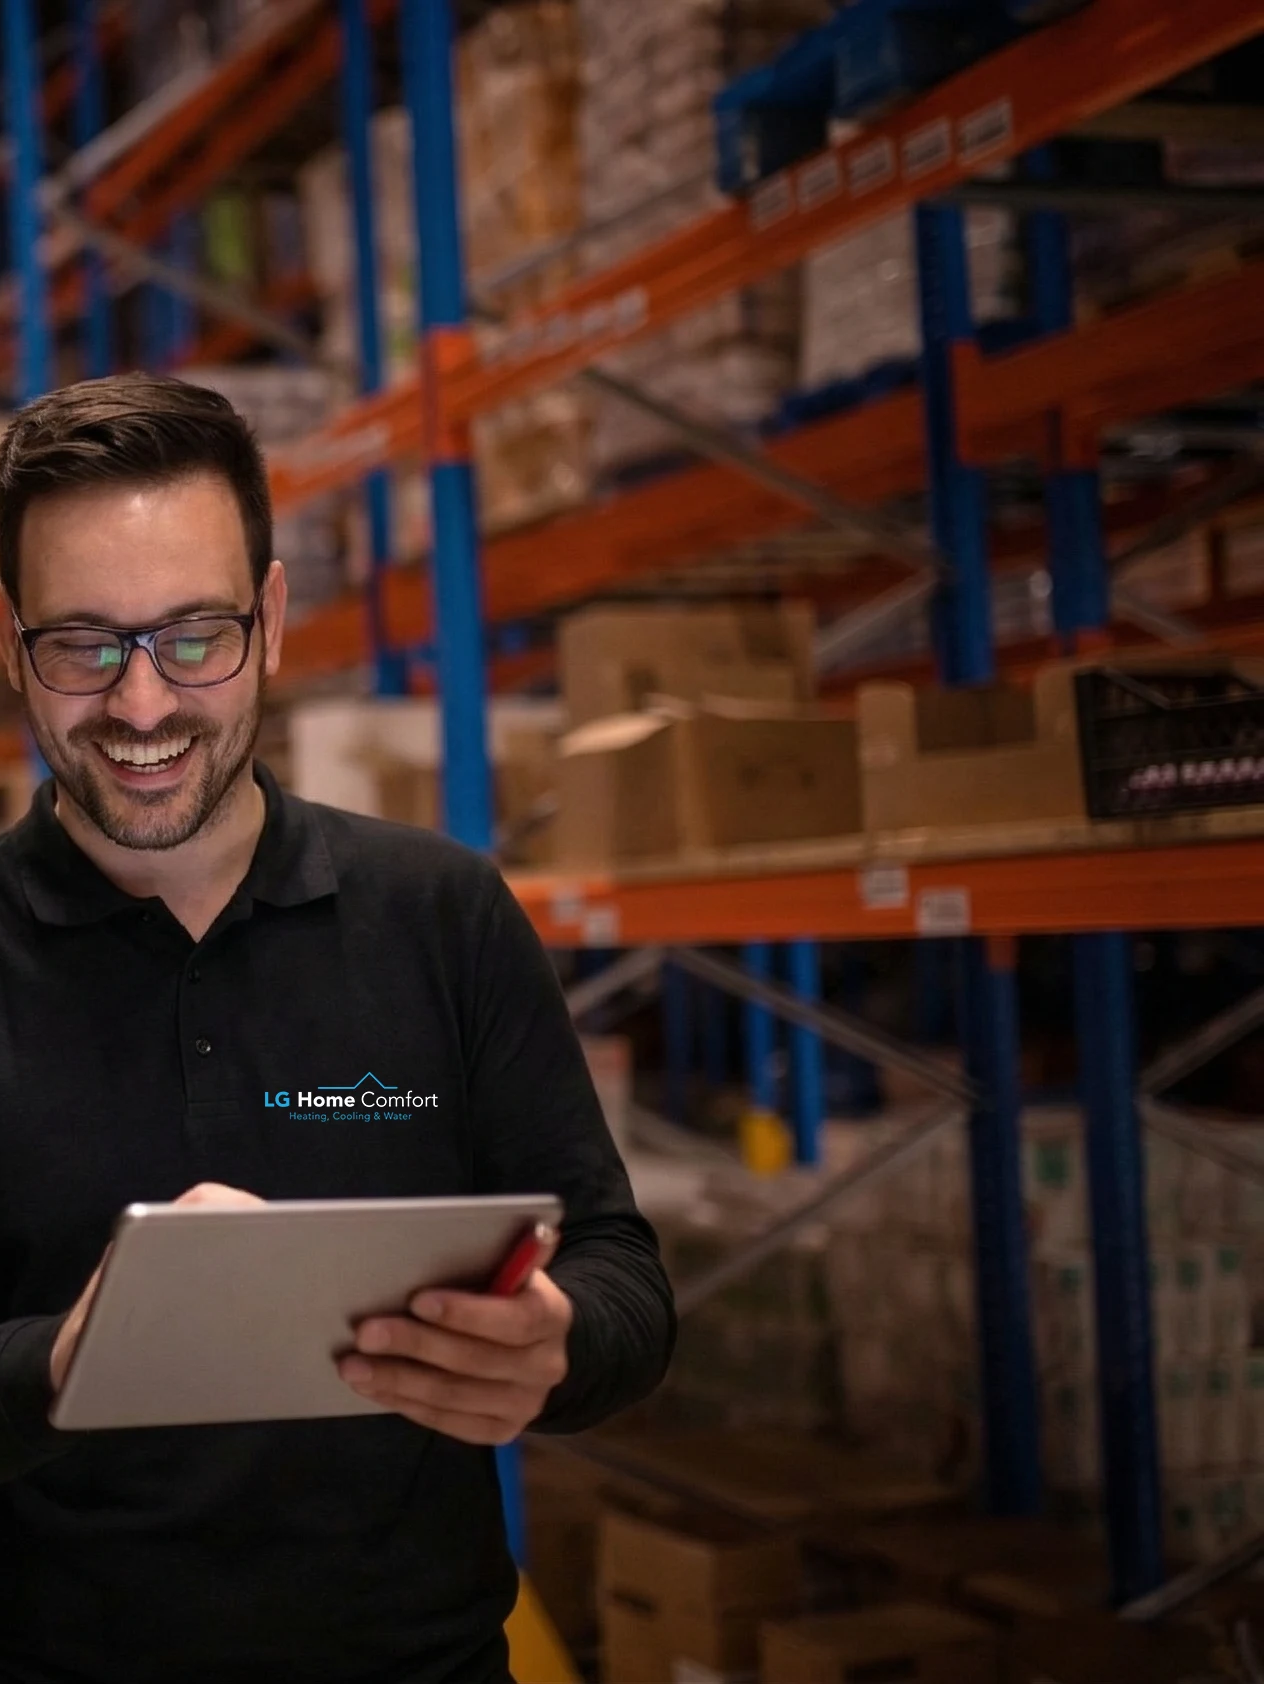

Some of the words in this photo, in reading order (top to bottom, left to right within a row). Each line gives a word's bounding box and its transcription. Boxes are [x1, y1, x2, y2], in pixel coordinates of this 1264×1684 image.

[264, 1091, 290, 1108] LG
[297, 1091, 355, 1108] Home
[361, 1090, 438, 1108] Comfort
[289, 1111, 330, 1122] Heating,
[332, 1111, 371, 1122] Cooling
[373, 1112, 381, 1120] &
[383, 1111, 412, 1120] Water
